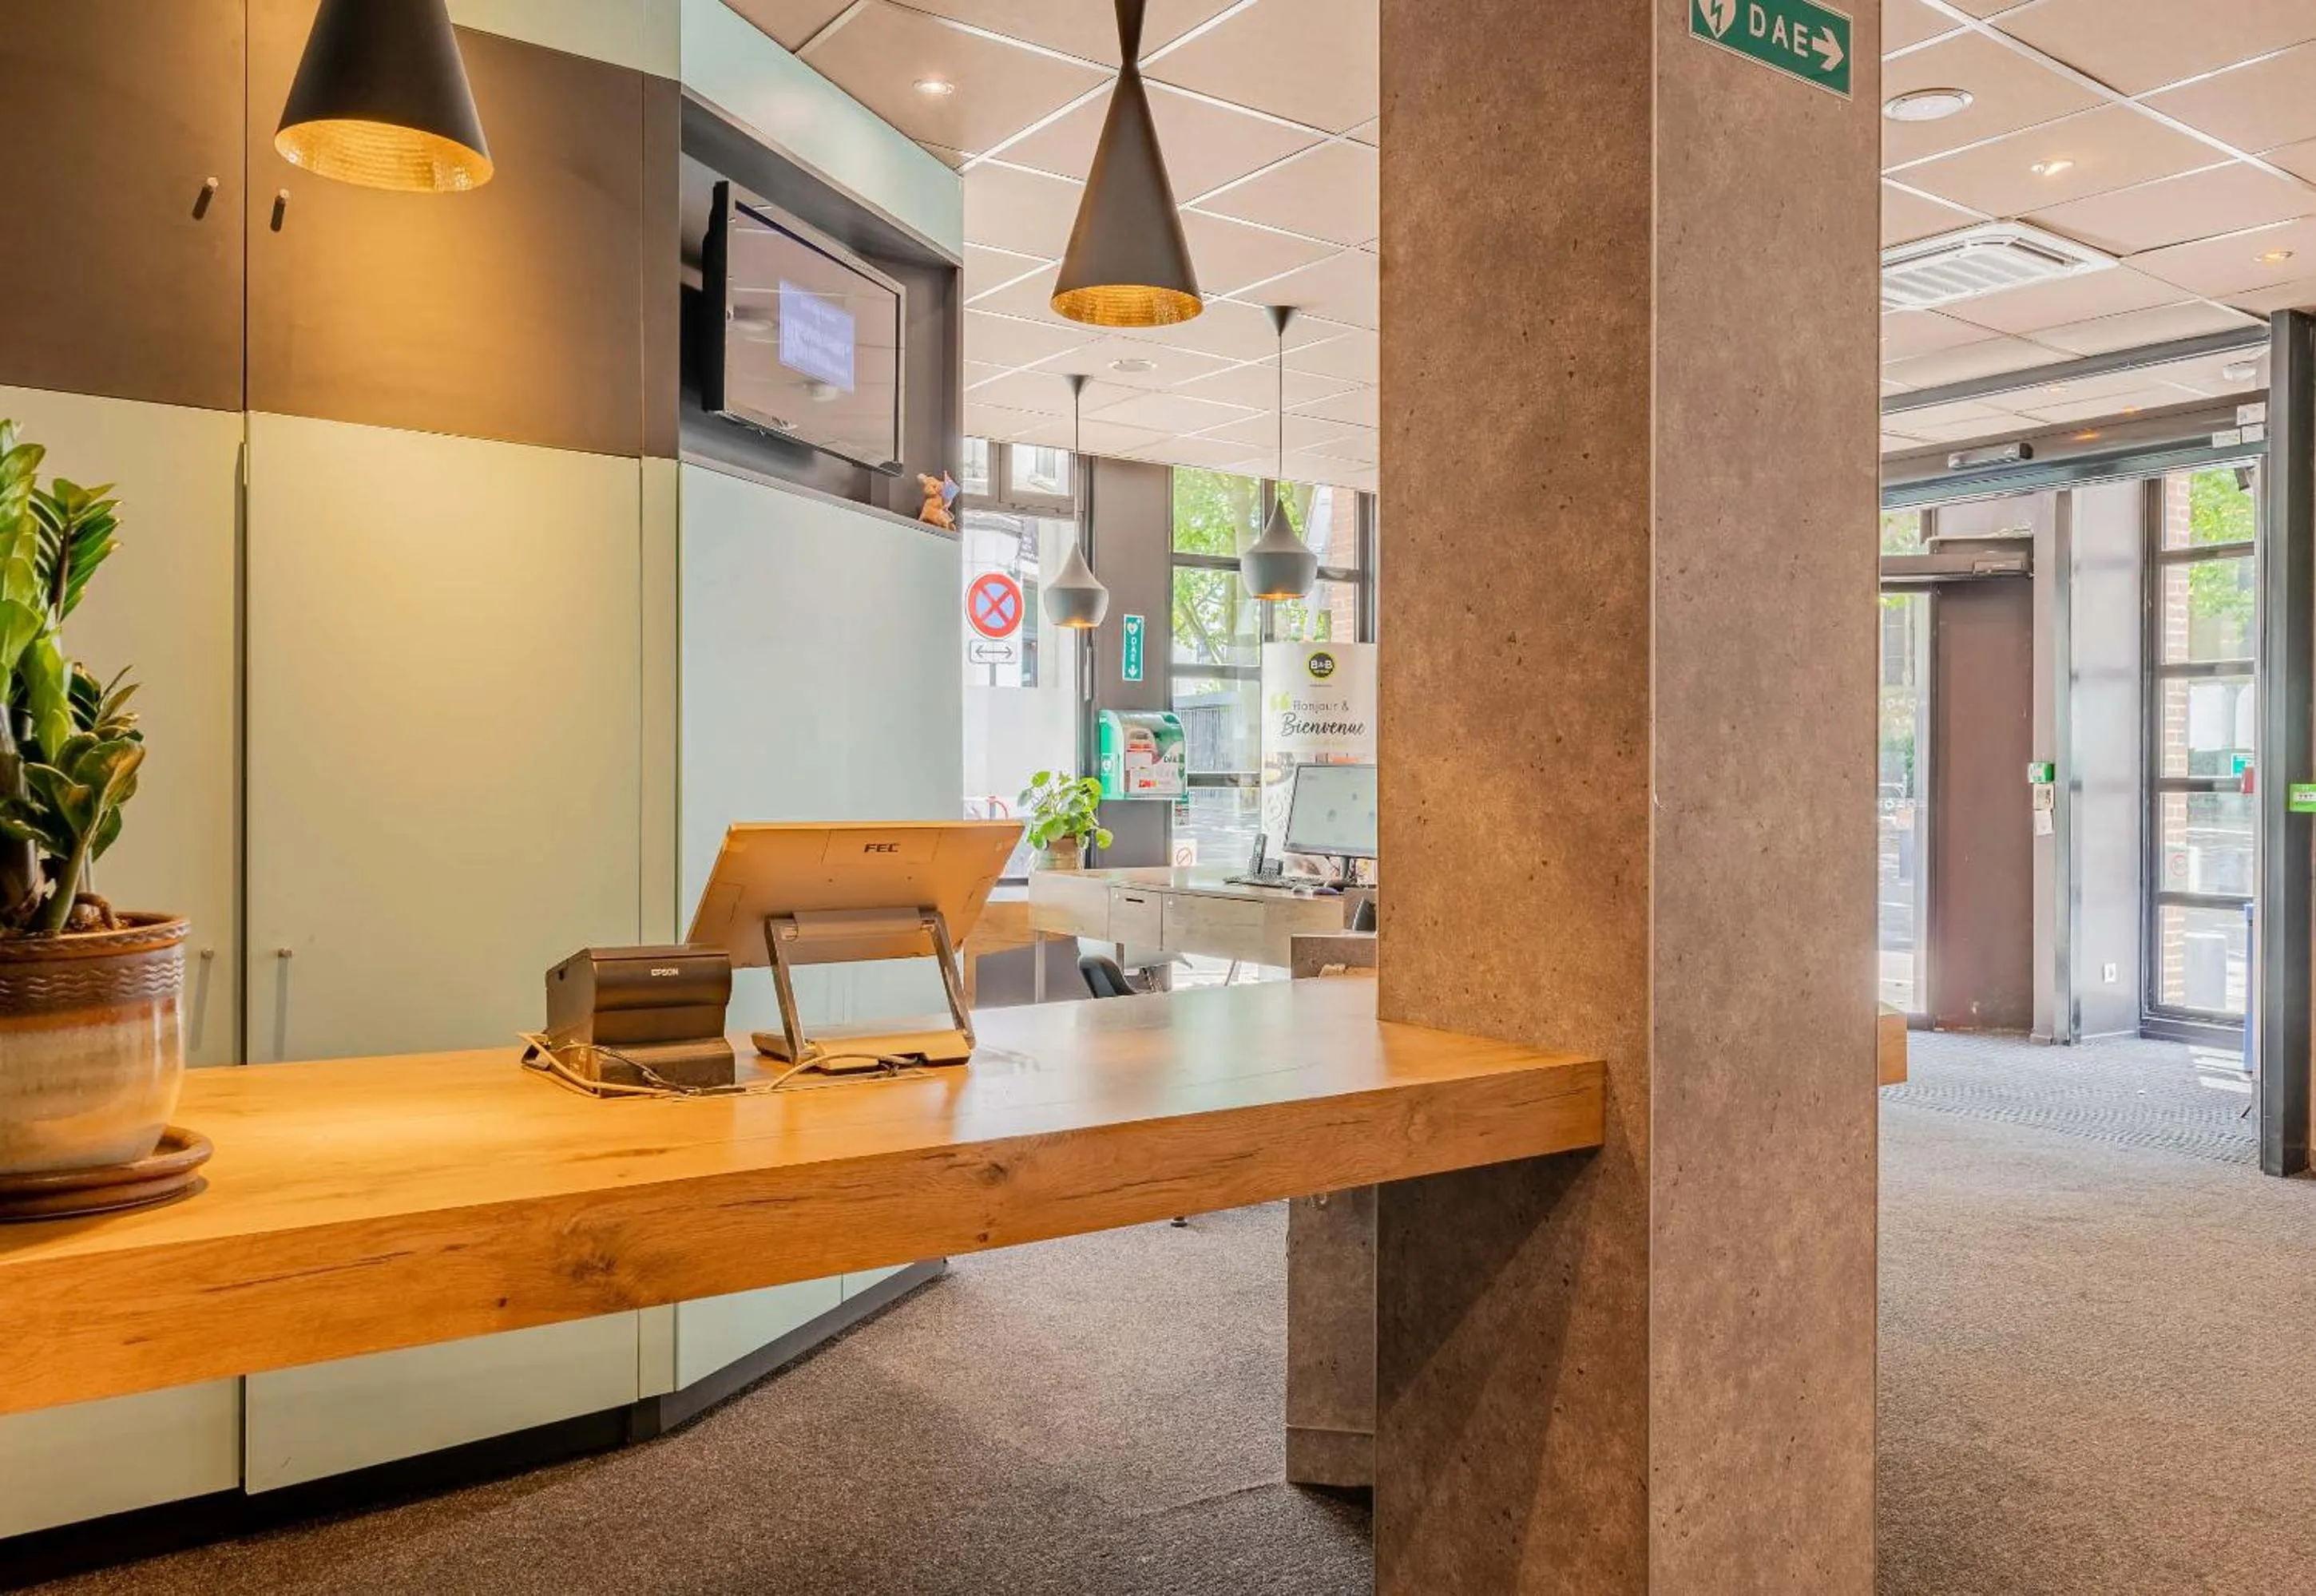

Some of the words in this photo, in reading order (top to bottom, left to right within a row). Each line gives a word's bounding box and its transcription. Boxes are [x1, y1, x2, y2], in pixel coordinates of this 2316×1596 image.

[1750, 2, 1809, 57] DAE
[1310, 659, 1333, 670] B&B
[1293, 699, 1339, 715] Bonjour
[1281, 711, 1366, 737] Bienvenue
[864, 842, 901, 853] FEC
[651, 968, 679, 976] EPSON
